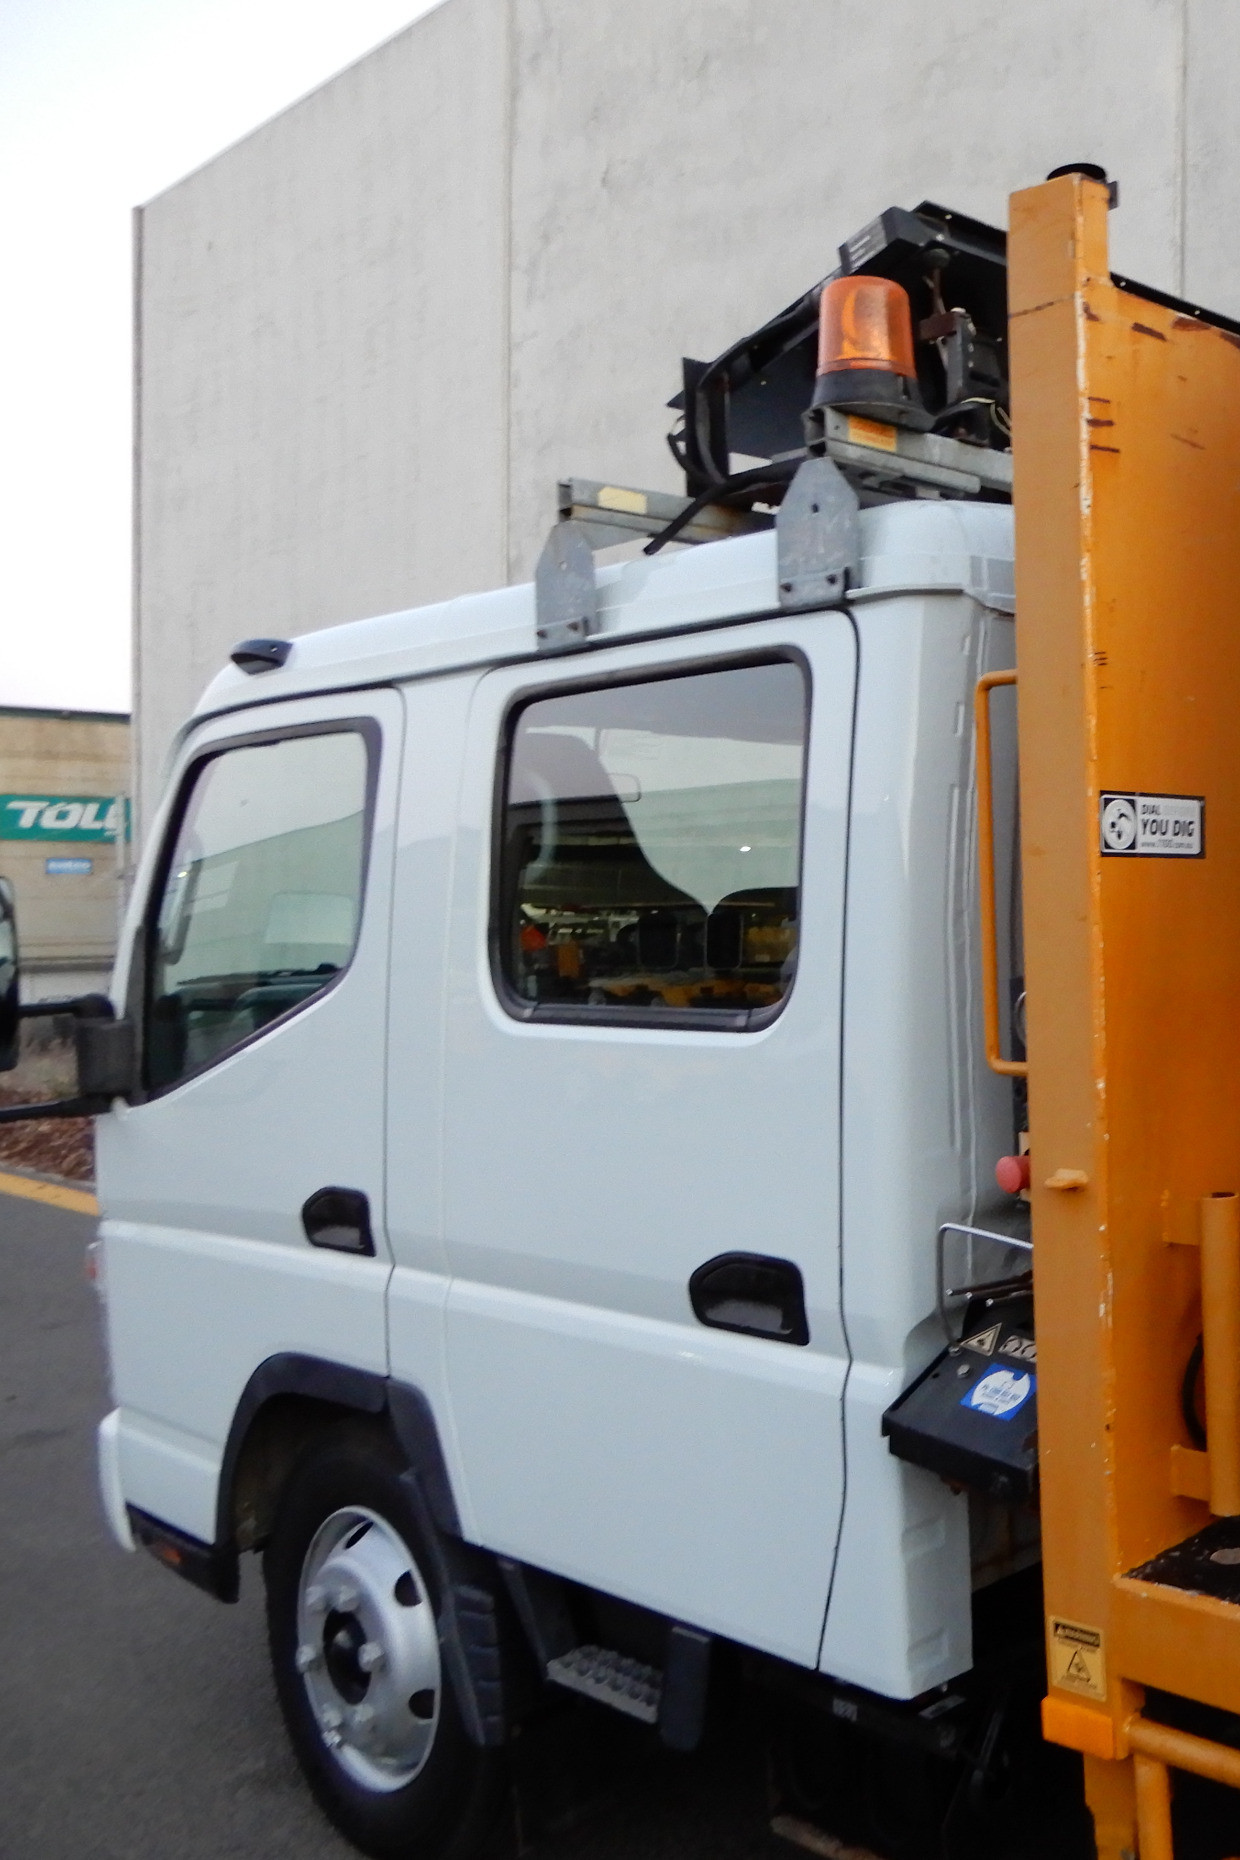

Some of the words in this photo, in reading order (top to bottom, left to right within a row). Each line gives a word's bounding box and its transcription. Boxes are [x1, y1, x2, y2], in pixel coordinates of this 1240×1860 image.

[1141, 804, 1161, 816] DIAL
[1141, 818, 1169, 836] YOU
[1173, 820, 1195, 838] DIG
